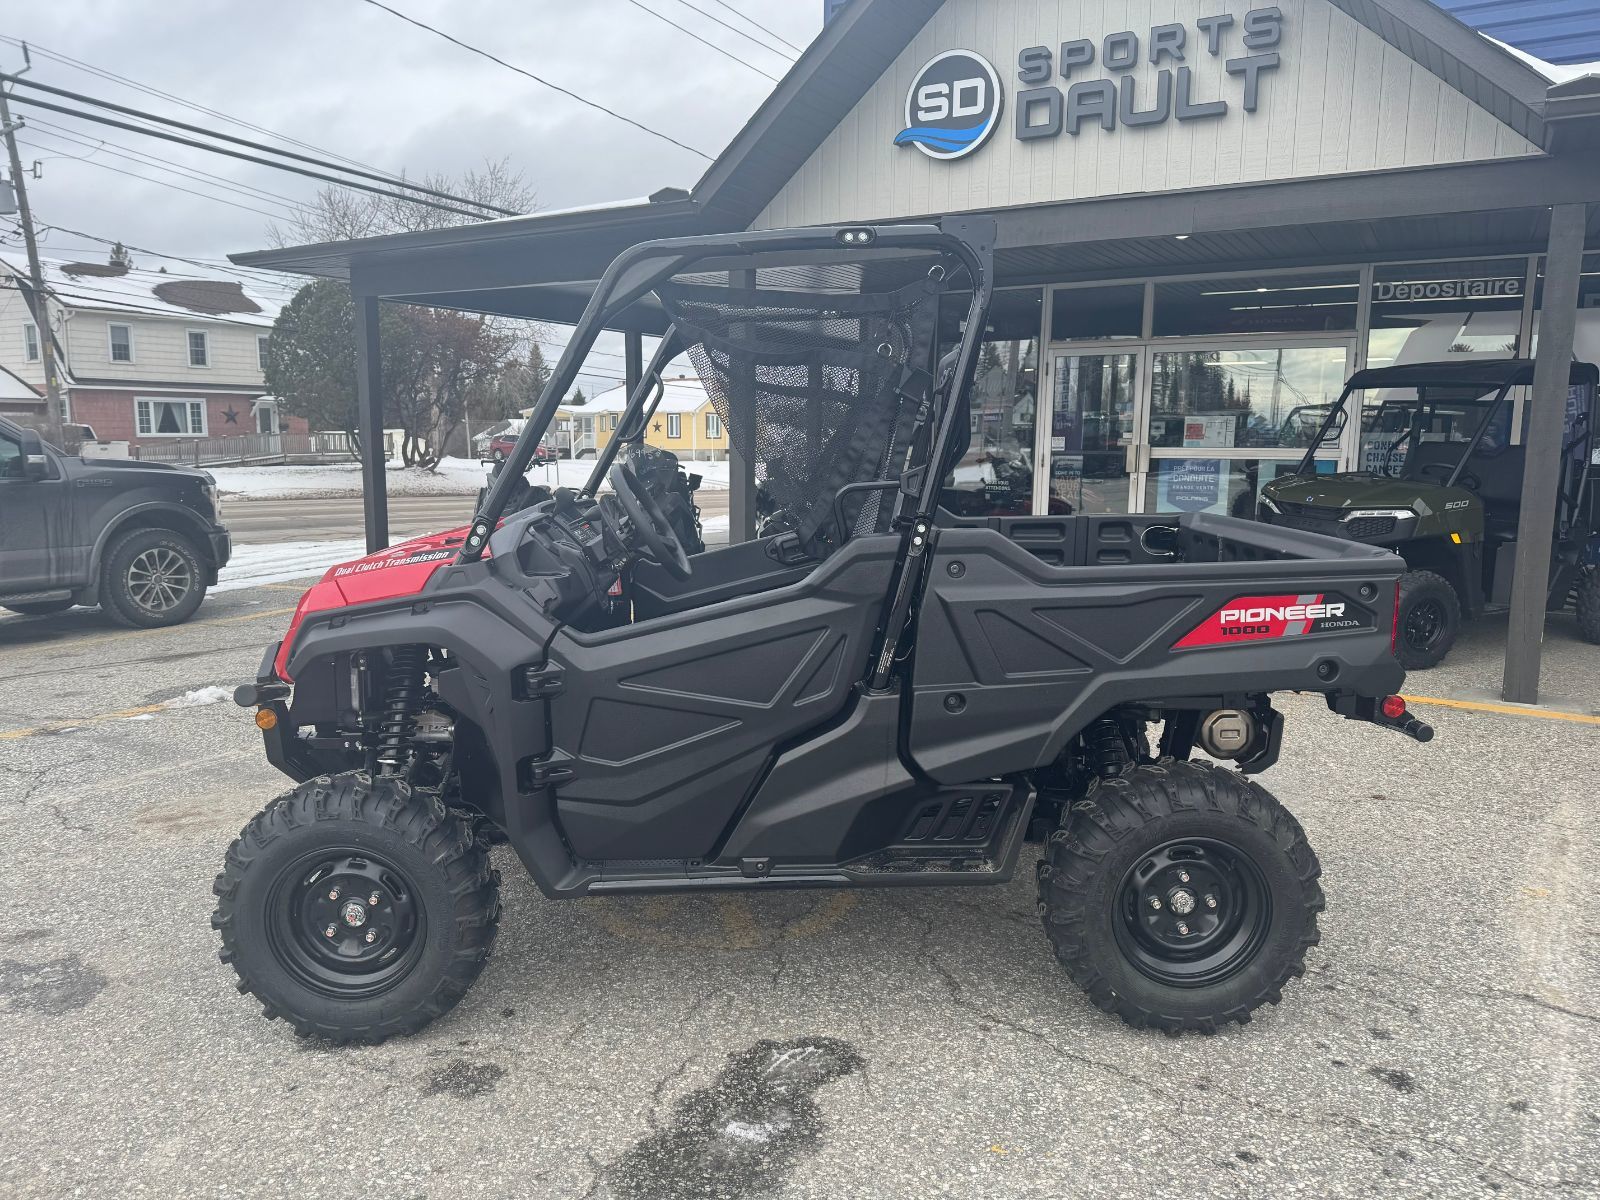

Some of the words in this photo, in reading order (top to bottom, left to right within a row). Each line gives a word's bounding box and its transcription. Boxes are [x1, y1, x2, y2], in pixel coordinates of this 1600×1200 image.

[1017, 6, 1283, 84] SPORTS
[917, 77, 986, 122] SD
[1015, 53, 1280, 141] DAULT
[1444, 499, 1469, 510] 500
[334, 564, 355, 577] Dual
[355, 560, 383, 573] Clutch
[384, 551, 450, 568] Transmission
[1220, 602, 1345, 624] PIONEER
[1320, 620, 1361, 629] HONDA
[1220, 625, 1270, 636] 1000
